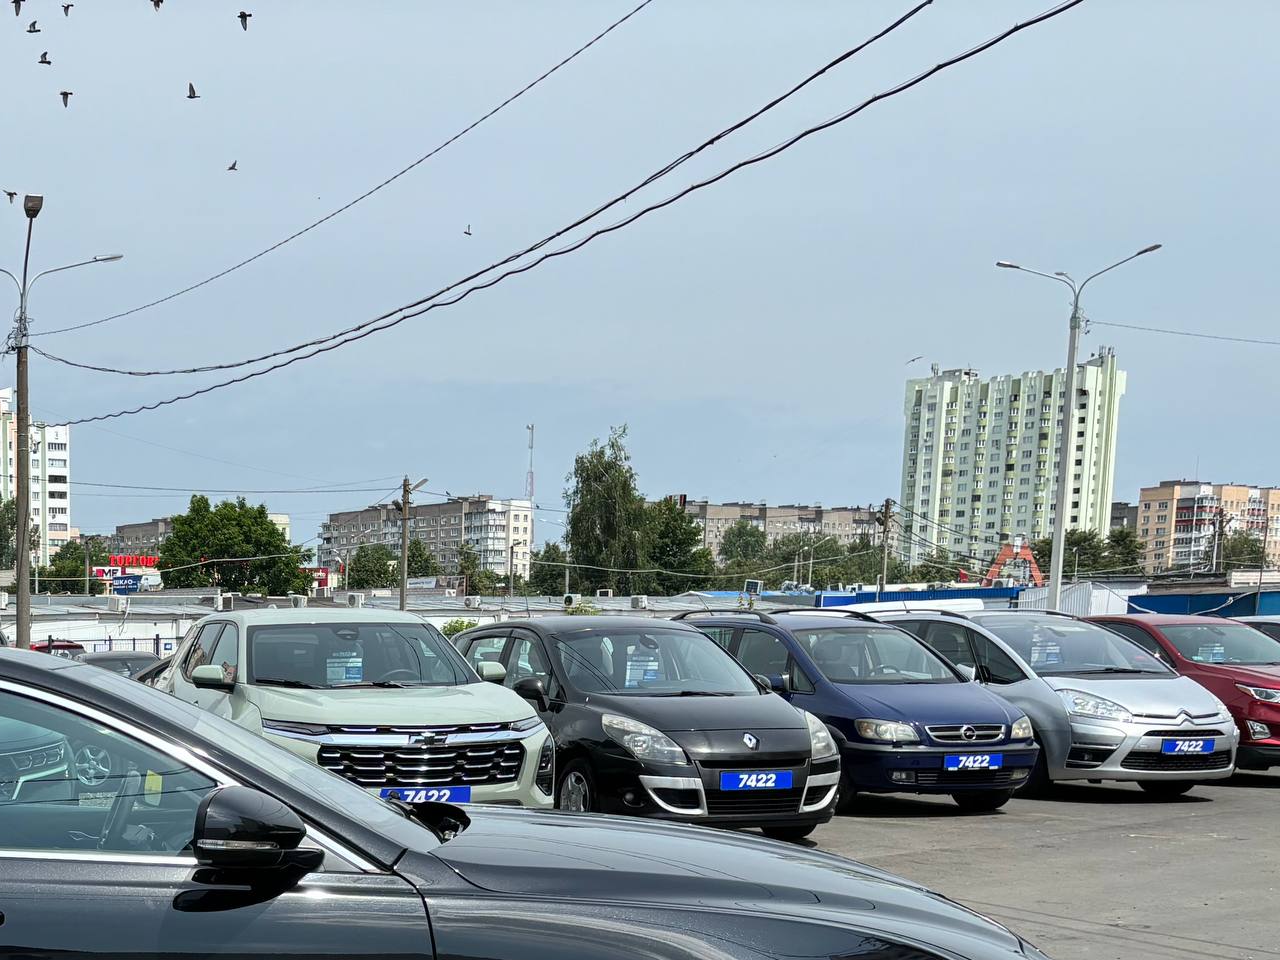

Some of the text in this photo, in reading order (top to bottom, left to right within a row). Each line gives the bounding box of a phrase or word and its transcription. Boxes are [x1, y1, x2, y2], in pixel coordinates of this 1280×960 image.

[109, 555, 160, 567] ТОРГОВ
[1174, 740, 1204, 752] 7422
[958, 755, 990, 768] 7422
[738, 773, 776, 788] 7422
[404, 789, 451, 803] 7422
